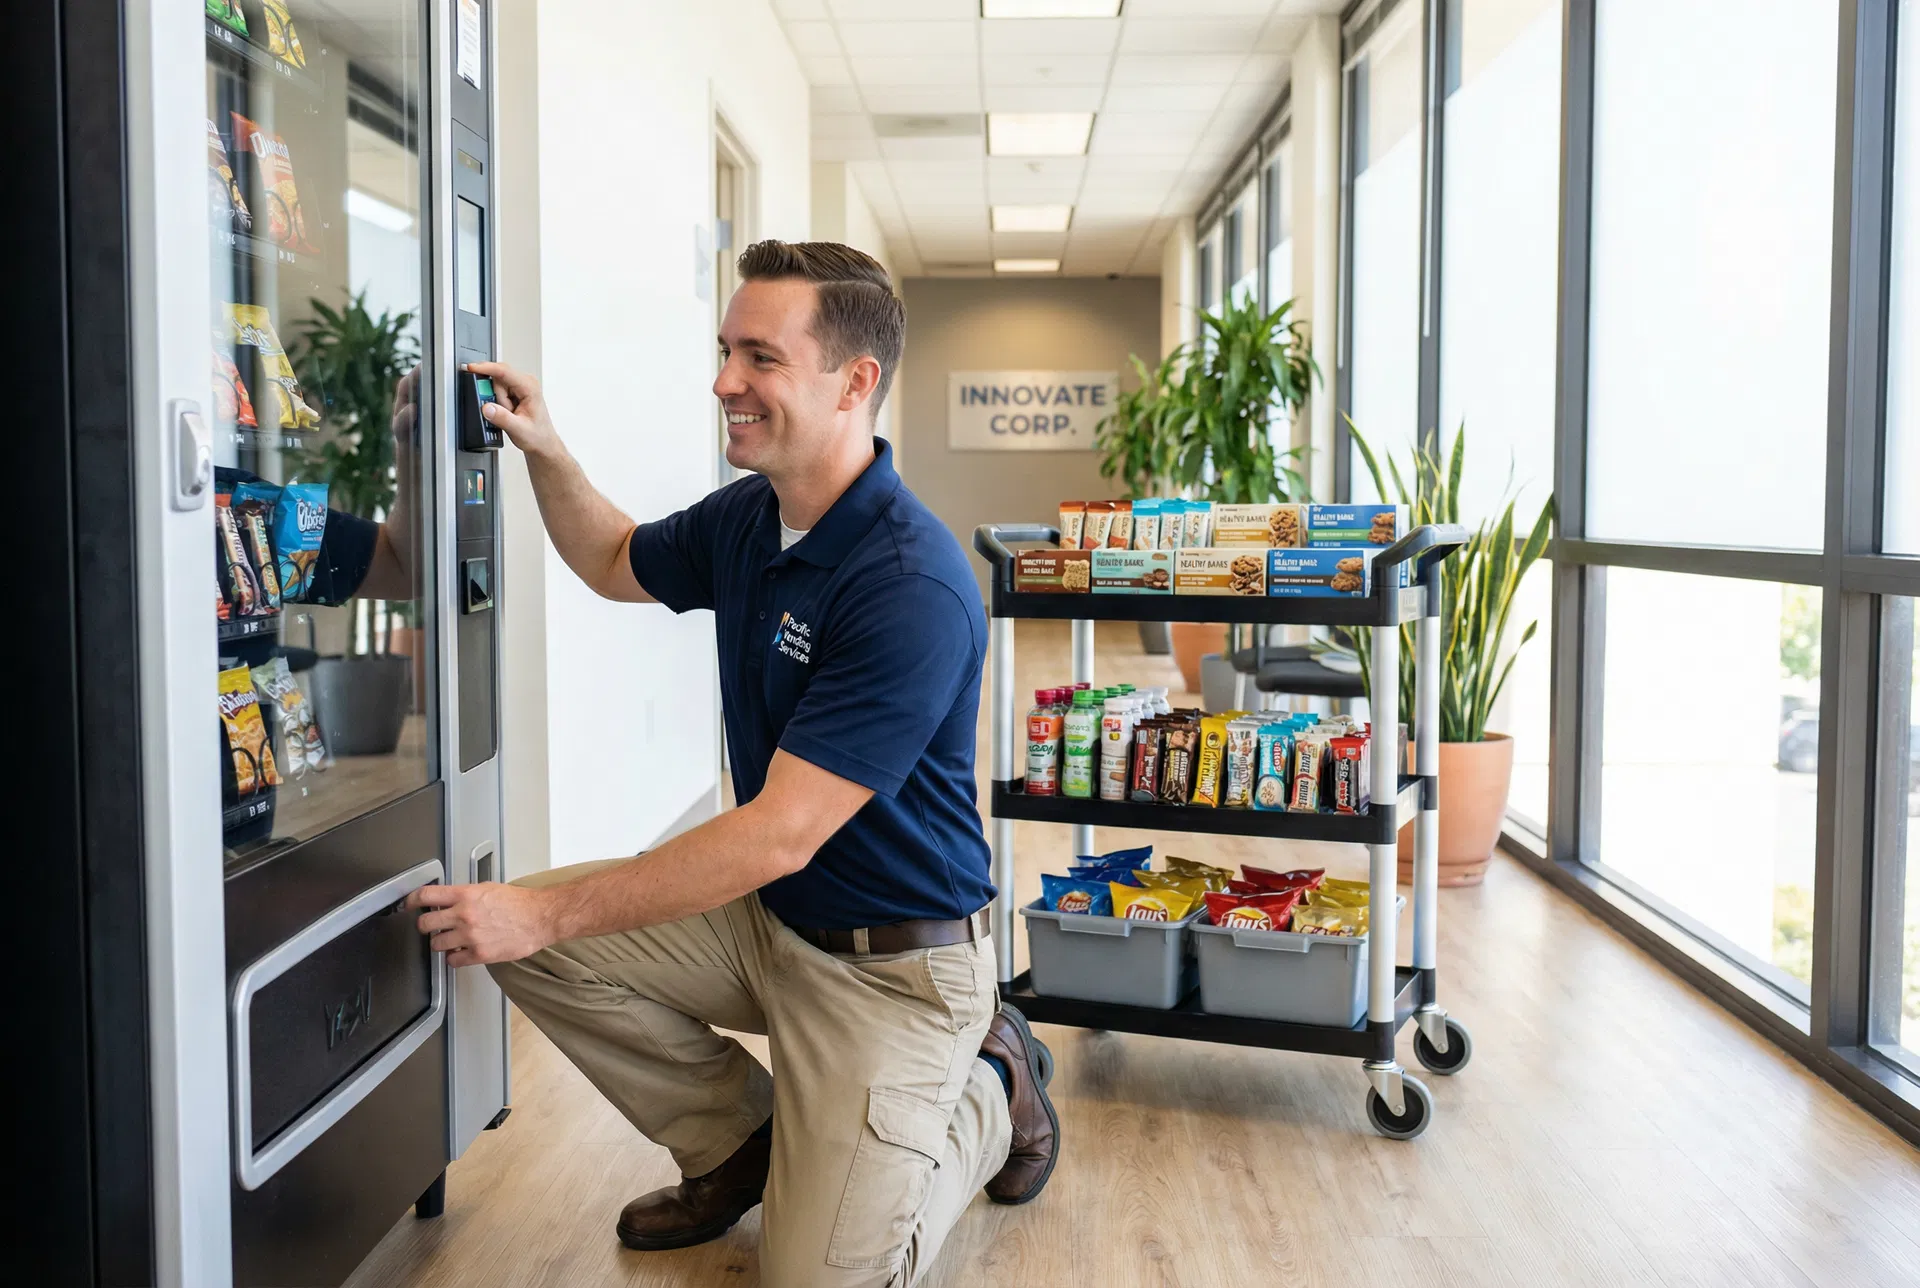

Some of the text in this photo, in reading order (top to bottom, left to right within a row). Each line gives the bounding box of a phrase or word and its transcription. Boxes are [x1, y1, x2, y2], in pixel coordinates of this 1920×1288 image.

[960, 384, 1107, 406] INNOVATE
[990, 414, 1077, 435] CORP.
[778, 640, 810, 664] Services
